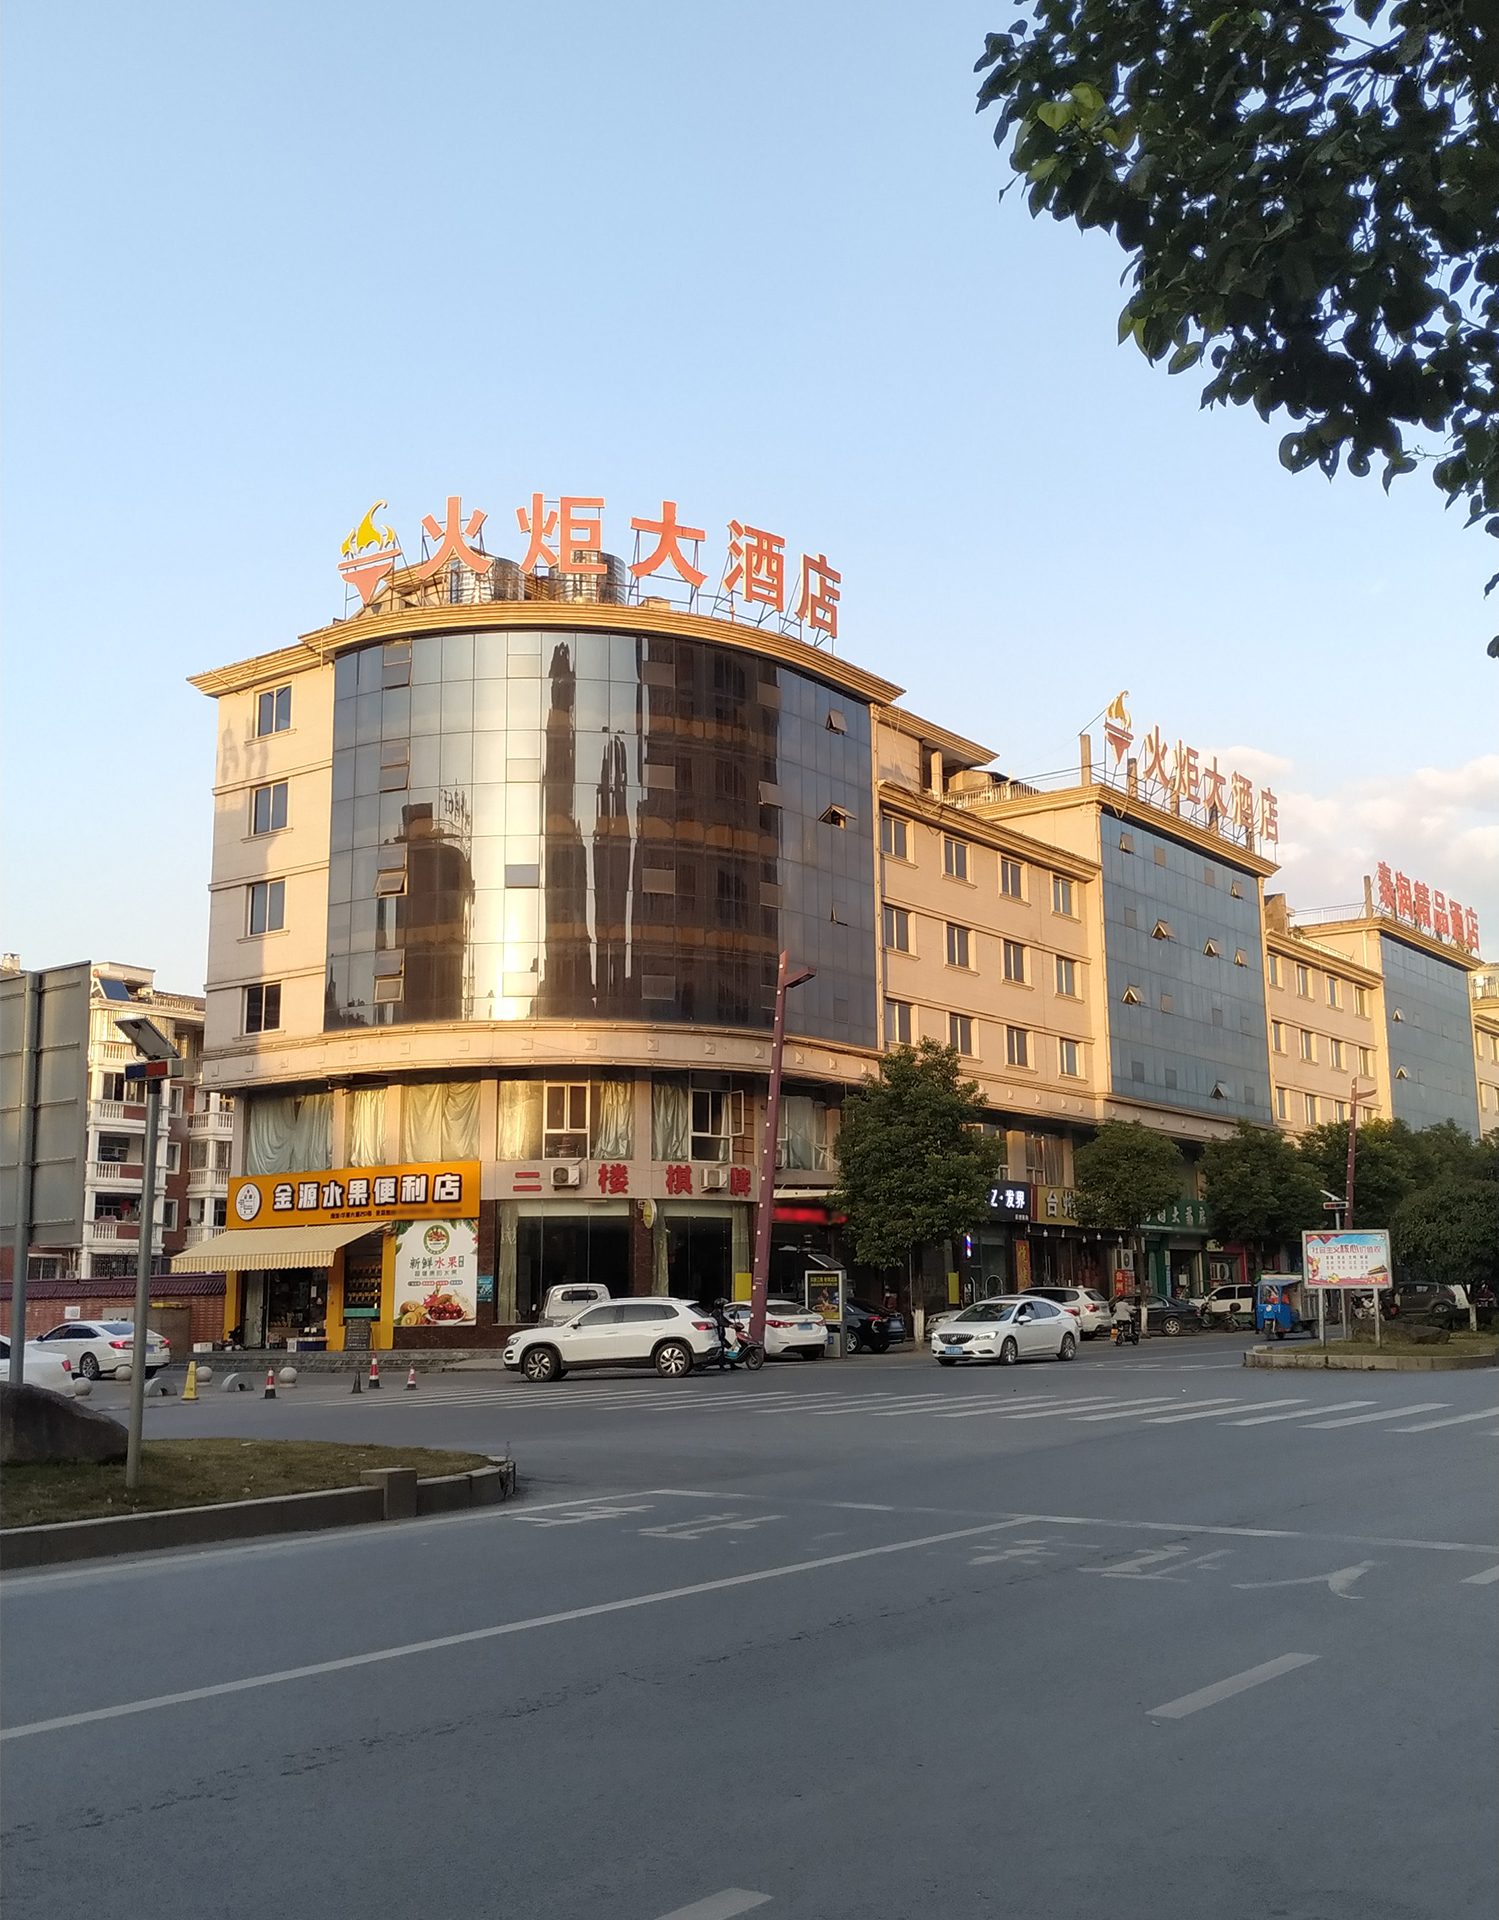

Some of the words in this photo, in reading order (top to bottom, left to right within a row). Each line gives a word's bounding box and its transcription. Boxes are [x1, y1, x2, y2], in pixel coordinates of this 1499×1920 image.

[416, 492, 842, 640] 火炬大酒店
[1143, 724, 1279, 844] 火炬大酒店
[273, 1174, 462, 1211] 金源水果便利店
[409, 1255, 458, 1270] 新鲜水果
[1312, 1244, 1382, 1254] 社会主义核心价值观
